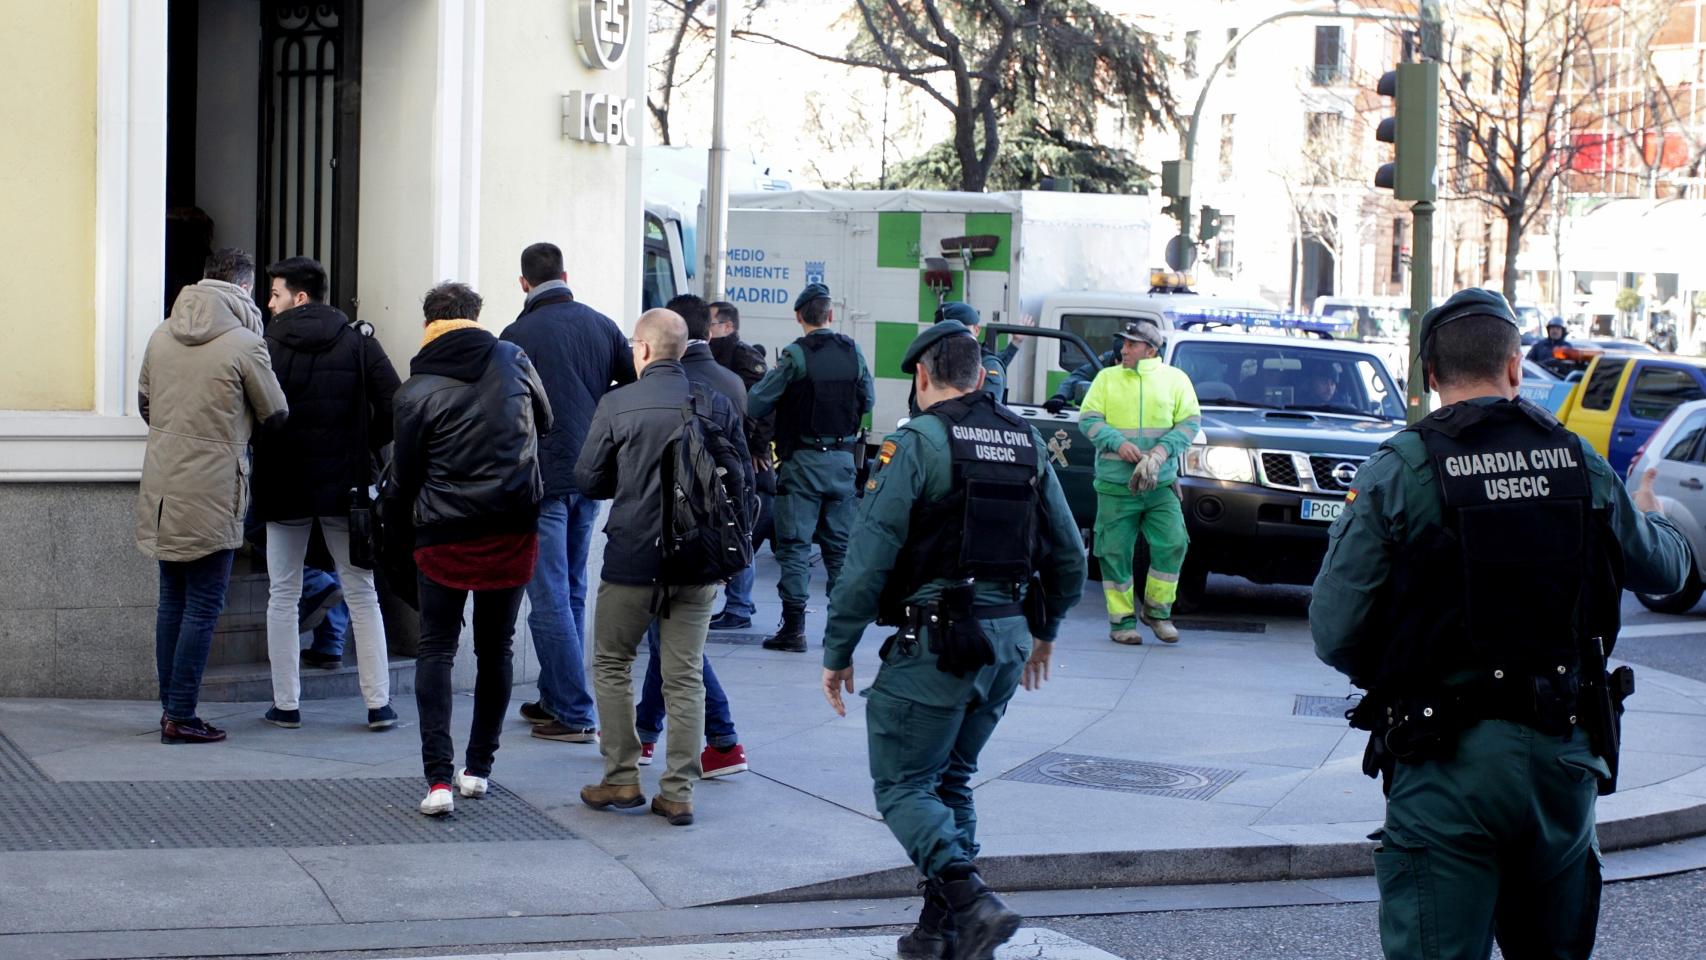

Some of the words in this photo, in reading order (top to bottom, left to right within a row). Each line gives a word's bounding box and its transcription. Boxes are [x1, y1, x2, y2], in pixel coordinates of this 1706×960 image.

[578, 90, 636, 147] ICBC
[726, 249, 765, 262] MEDIO
[725, 265, 790, 280] AMBIENTE
[725, 286, 789, 304] MADRID
[952, 425, 1002, 444] GUARDIA
[1003, 430, 1032, 448] CIVIL
[975, 444, 1016, 462] USECIC
[1445, 450, 1529, 477] GUARDIA
[1530, 447, 1578, 469] CIVIL
[1484, 475, 1550, 501] USECIC
